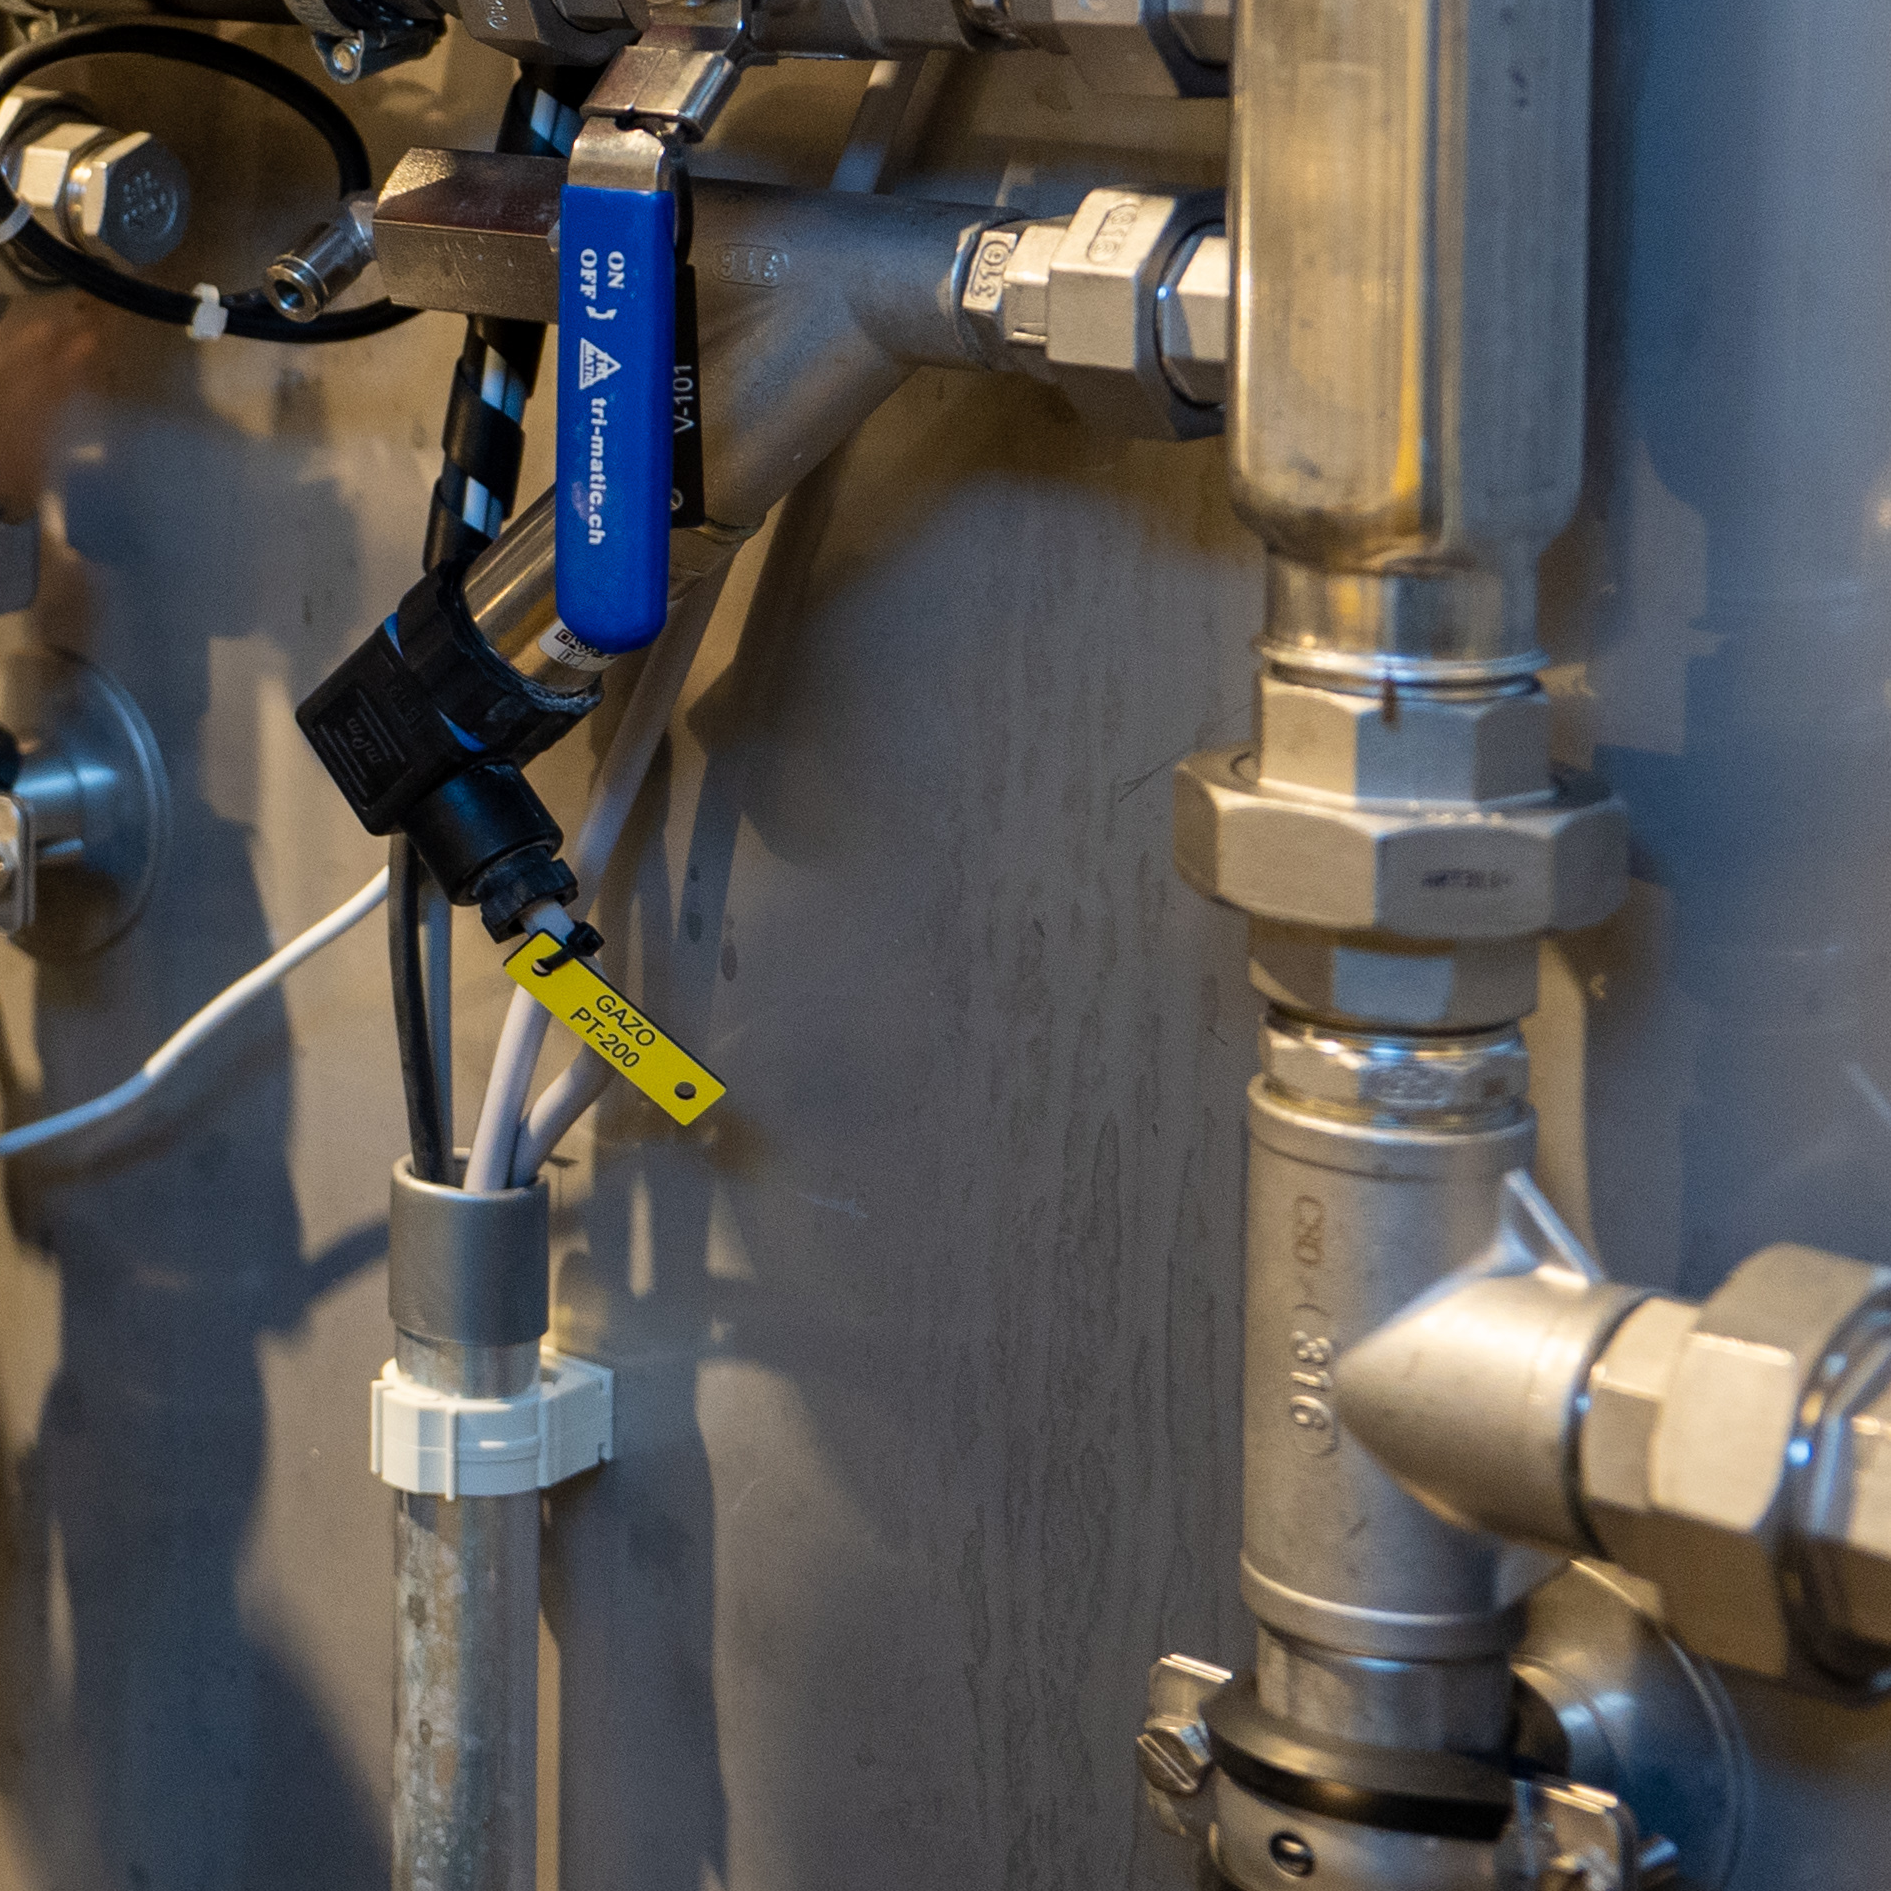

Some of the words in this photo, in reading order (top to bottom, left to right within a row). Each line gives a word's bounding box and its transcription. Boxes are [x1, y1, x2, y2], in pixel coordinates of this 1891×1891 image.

[580, 249, 597, 300] OFF
[608, 251, 625, 289] ON
[673, 365, 695, 433] V-101
[589, 397, 608, 545] tri-matic.ch
[570, 1007, 640, 1068] PT-200
[596, 995, 655, 1046] GAZO
